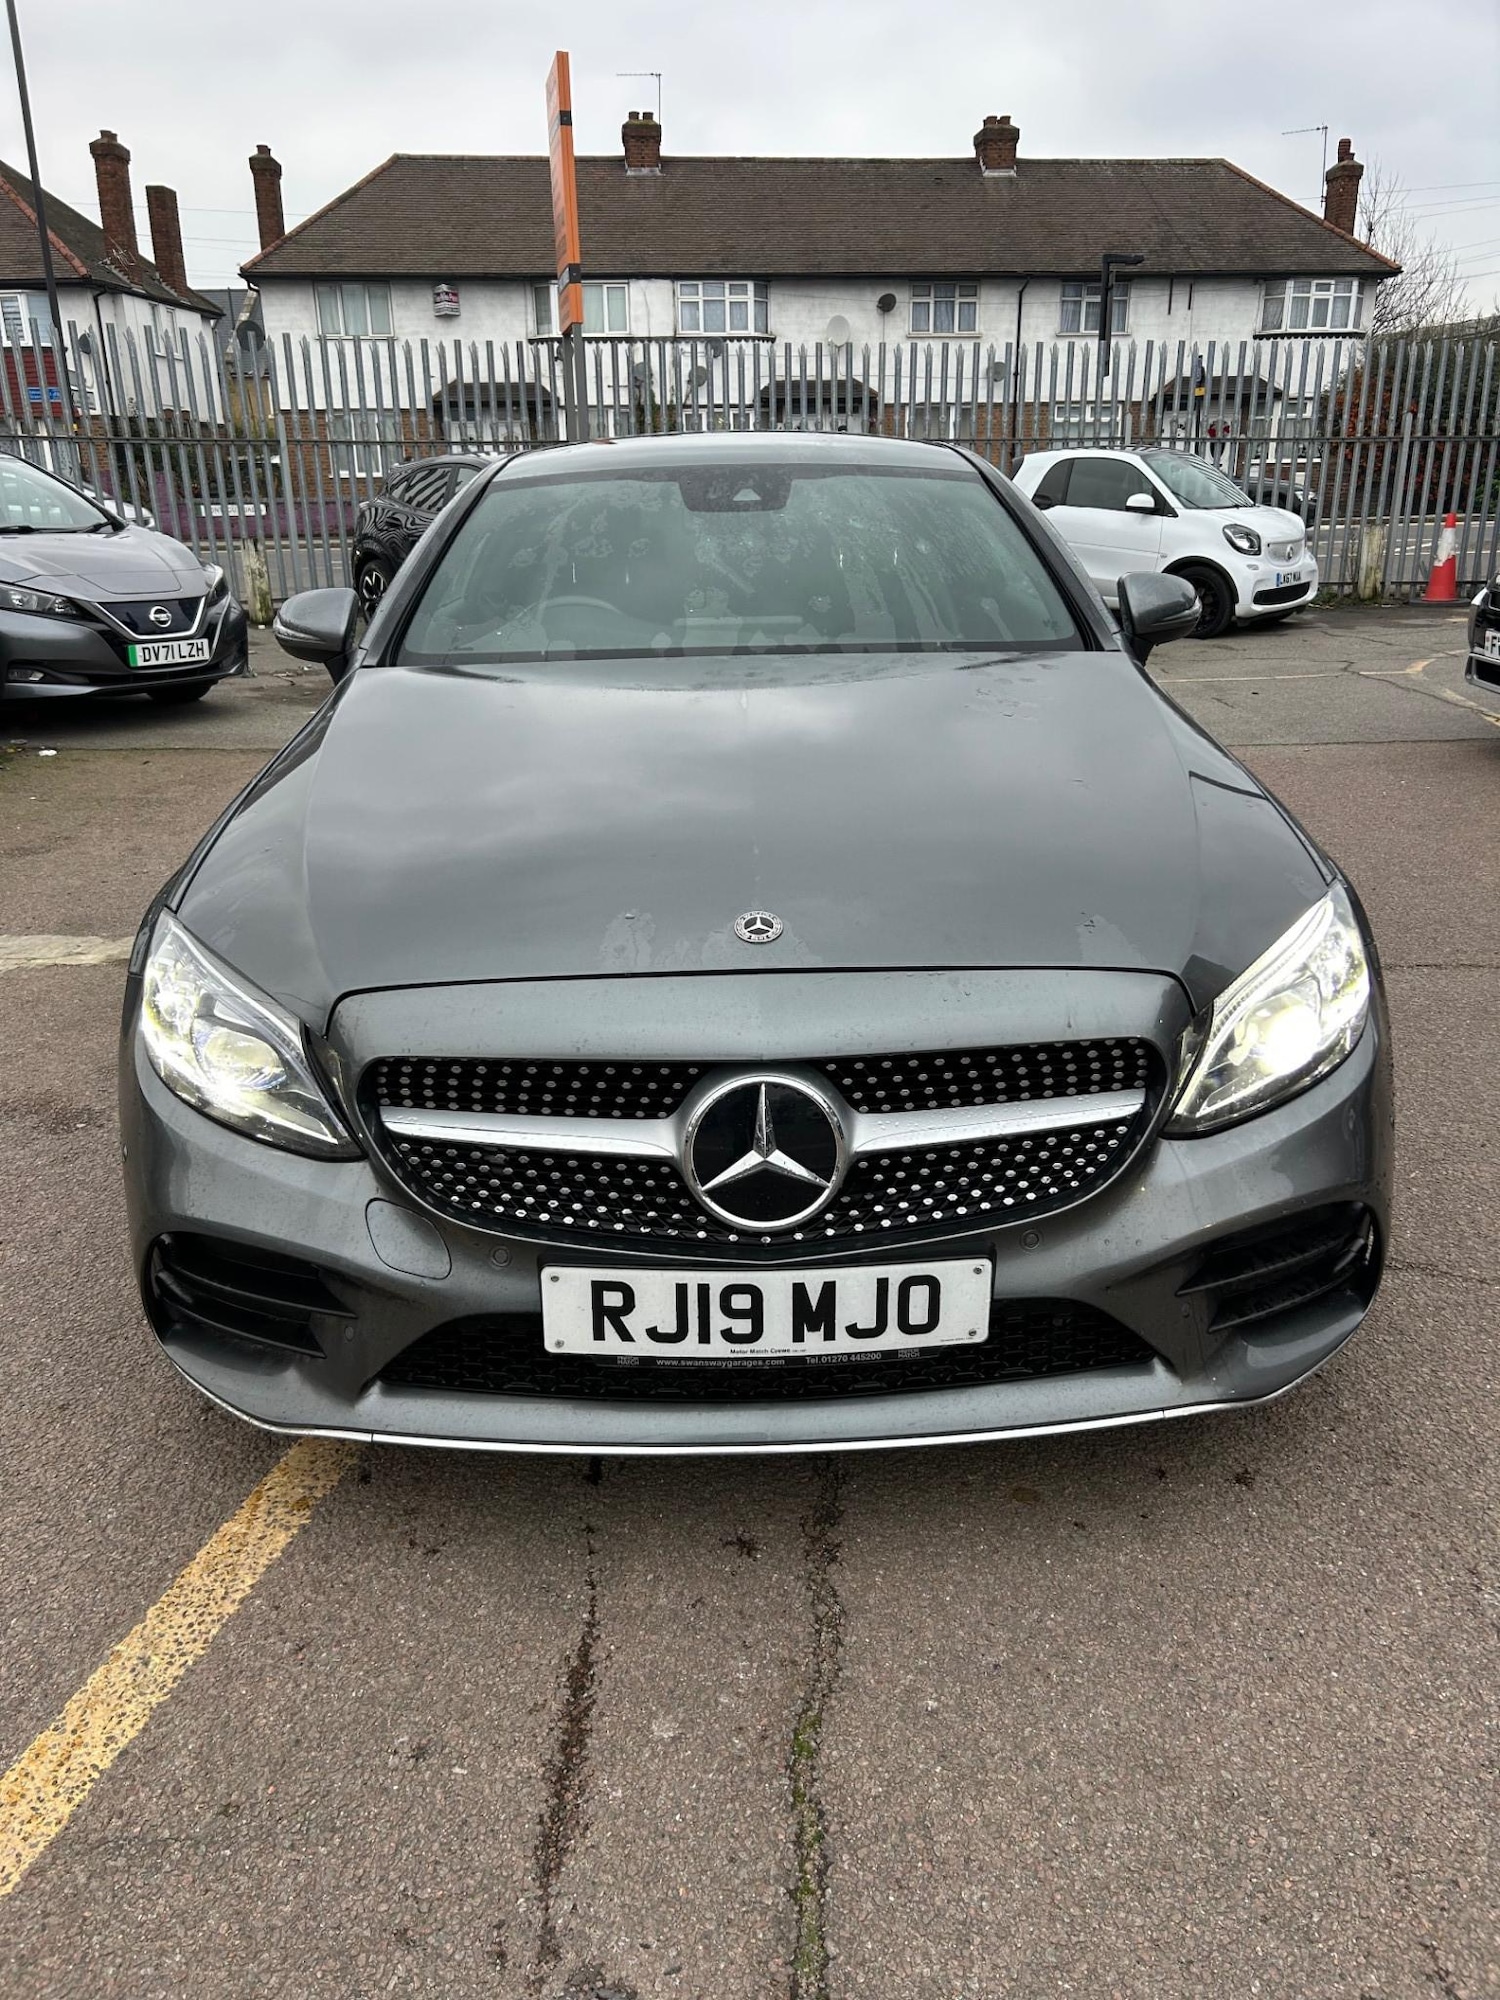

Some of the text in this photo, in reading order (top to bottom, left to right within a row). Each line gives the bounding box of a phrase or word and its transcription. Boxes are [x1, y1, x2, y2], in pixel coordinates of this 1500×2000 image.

[142, 642, 204, 662] DV71 LZH
[590, 1274, 941, 1344] RJ19 MJO
[656, 1358, 785, 1368] www.swanswaygarages.com
[805, 1351, 882, 1365] Tel.01270 445200
